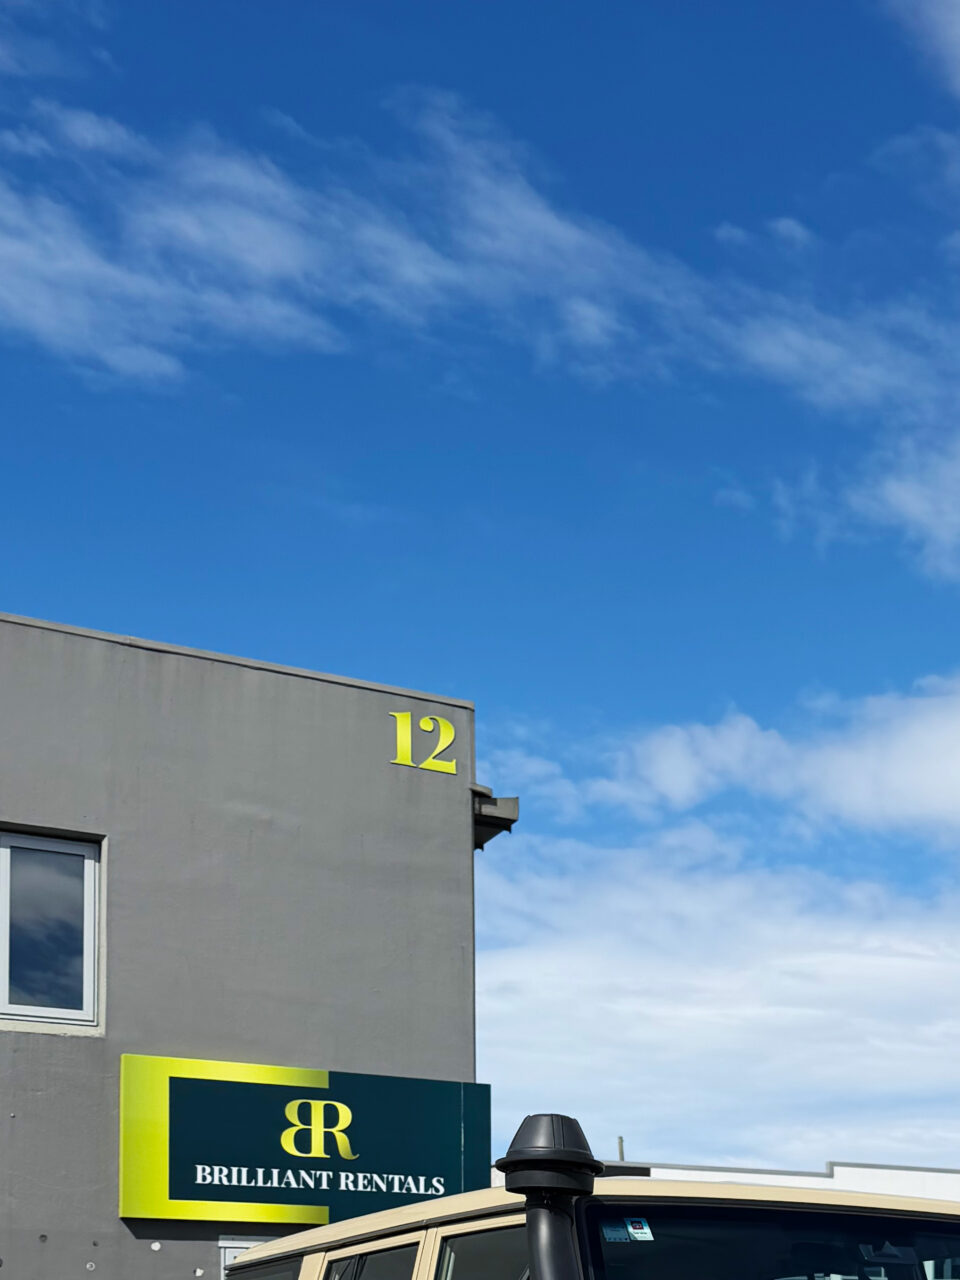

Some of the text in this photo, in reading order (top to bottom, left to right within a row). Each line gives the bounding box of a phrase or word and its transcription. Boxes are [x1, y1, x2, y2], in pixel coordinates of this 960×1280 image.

[388, 711, 457, 775] 12
[194, 1164, 445, 1196] BRILLIANT RENTALS
